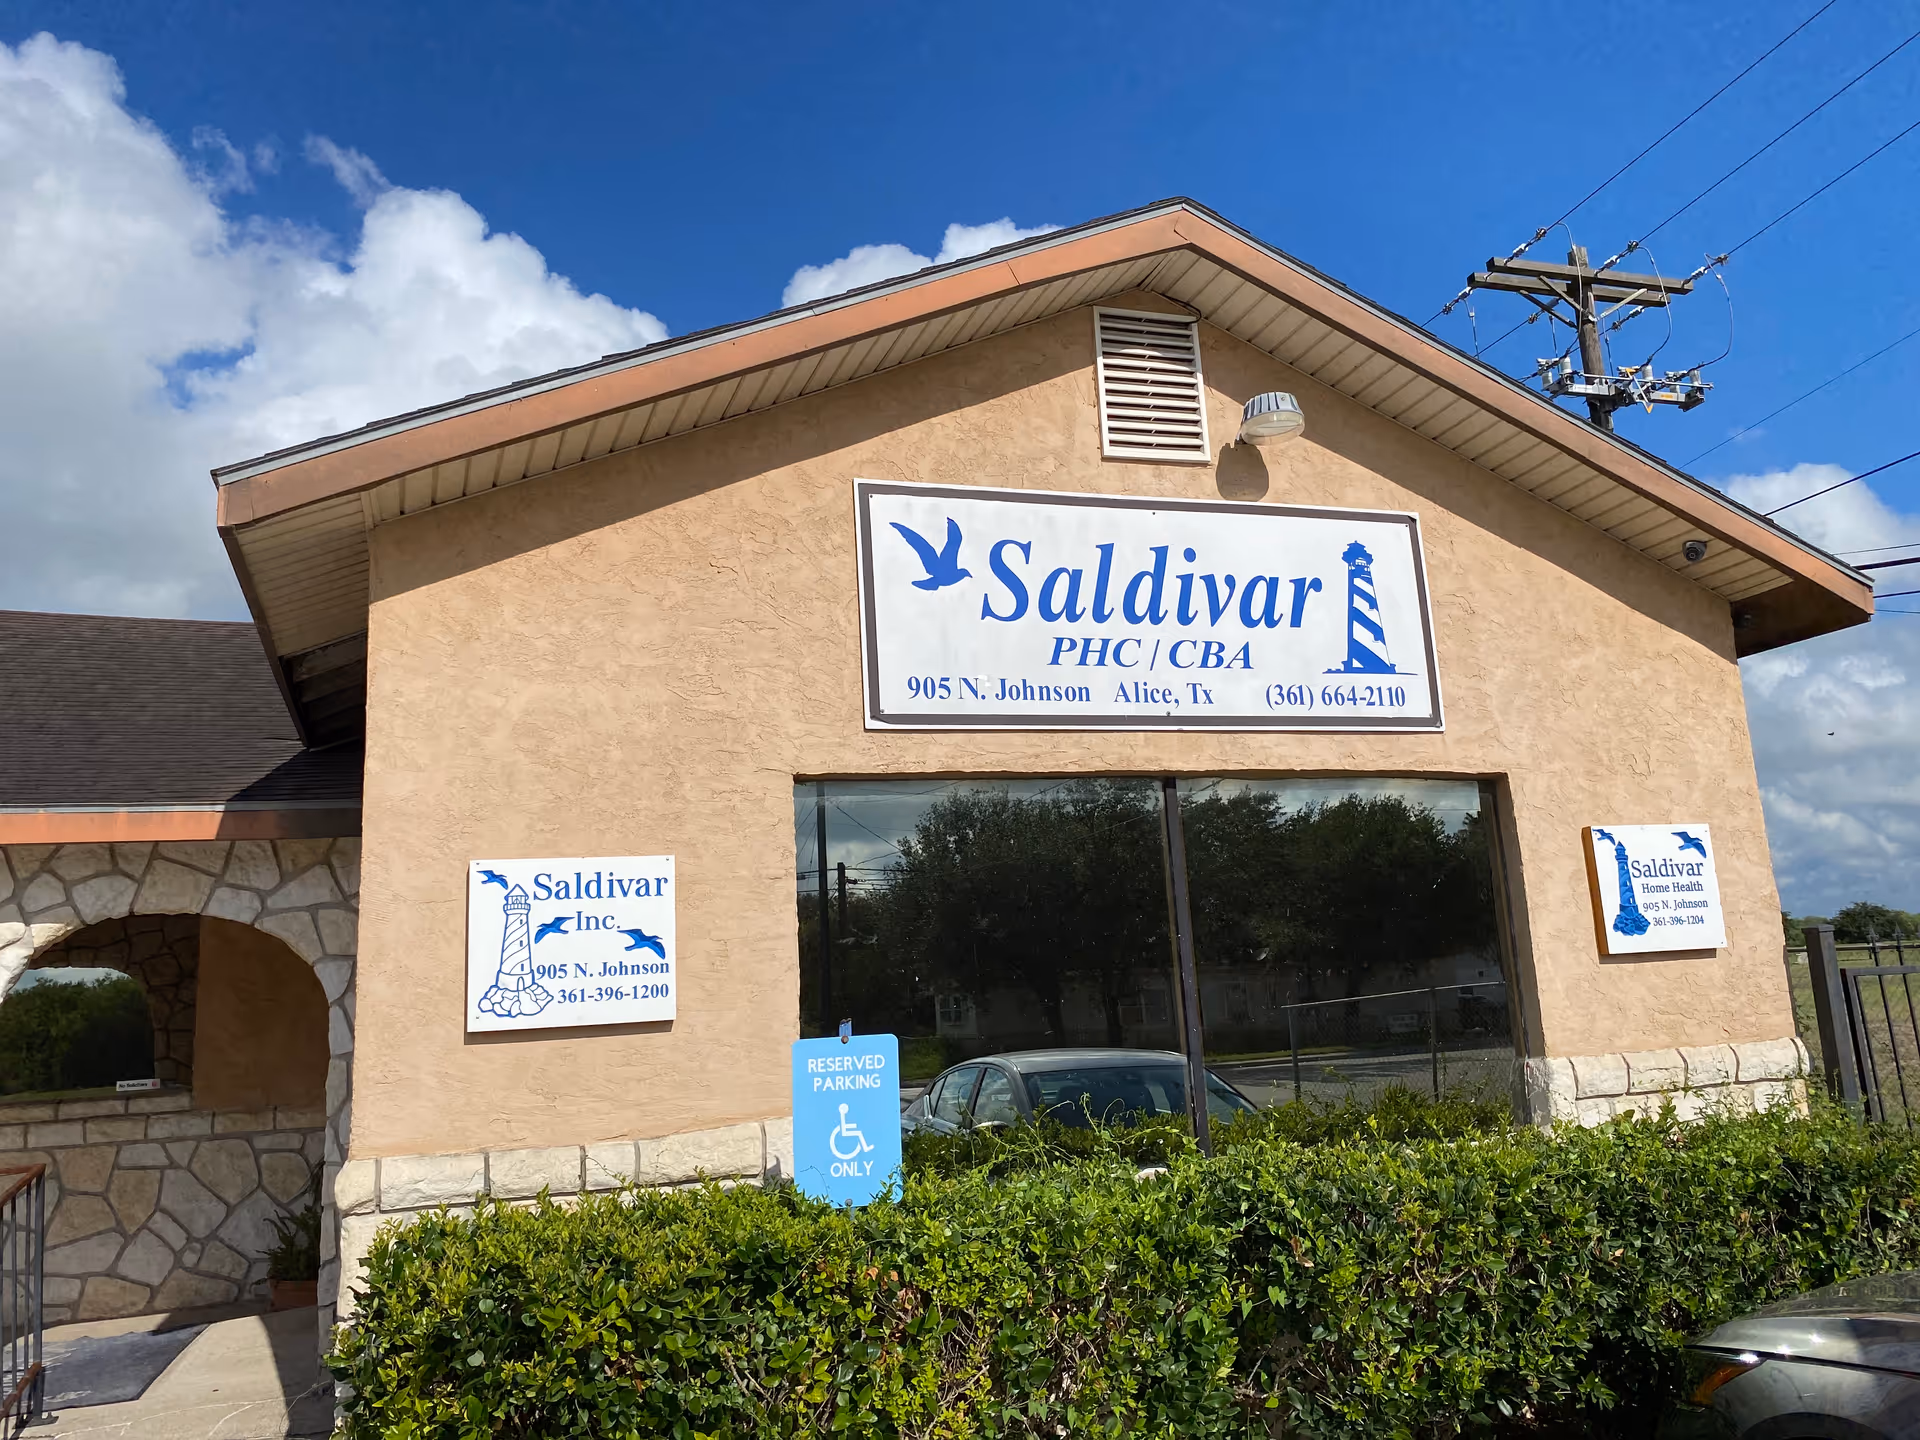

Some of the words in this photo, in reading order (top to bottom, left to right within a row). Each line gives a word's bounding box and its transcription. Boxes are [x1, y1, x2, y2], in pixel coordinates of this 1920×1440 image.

[981, 539, 1323, 629] Saldivar
[1047, 636, 1142, 668] PHC
[1169, 639, 1255, 670] CBA
[907, 675, 951, 700] 905
[958, 677, 986, 700] N.
[995, 677, 1091, 702] Johnson
[1113, 681, 1180, 708] Alice,
[1186, 682, 1214, 705] Tx
[1265, 683, 1314, 711] (361)
[1322, 684, 1406, 707] 664-2110
[1631, 858, 1704, 879] Saldivar
[533, 871, 669, 901] Saldivar
[1641, 883, 1670, 894] Home
[1672, 881, 1704, 892] Health
[1642, 901, 1660, 912] 905
[1661, 900, 1672, 910] N.
[1673, 898, 1709, 911] Johnson
[574, 910, 621, 931] Inc.
[1652, 915, 1705, 927] 361-396-1204
[536, 963, 568, 981] 905
[573, 962, 594, 978] N.
[598, 960, 670, 977] Johnson
[557, 983, 670, 1004] 361-396-1200
[808, 1054, 885, 1073] RESERVED
[813, 1074, 881, 1092] PARKING
[830, 1160, 874, 1178] ONLY
